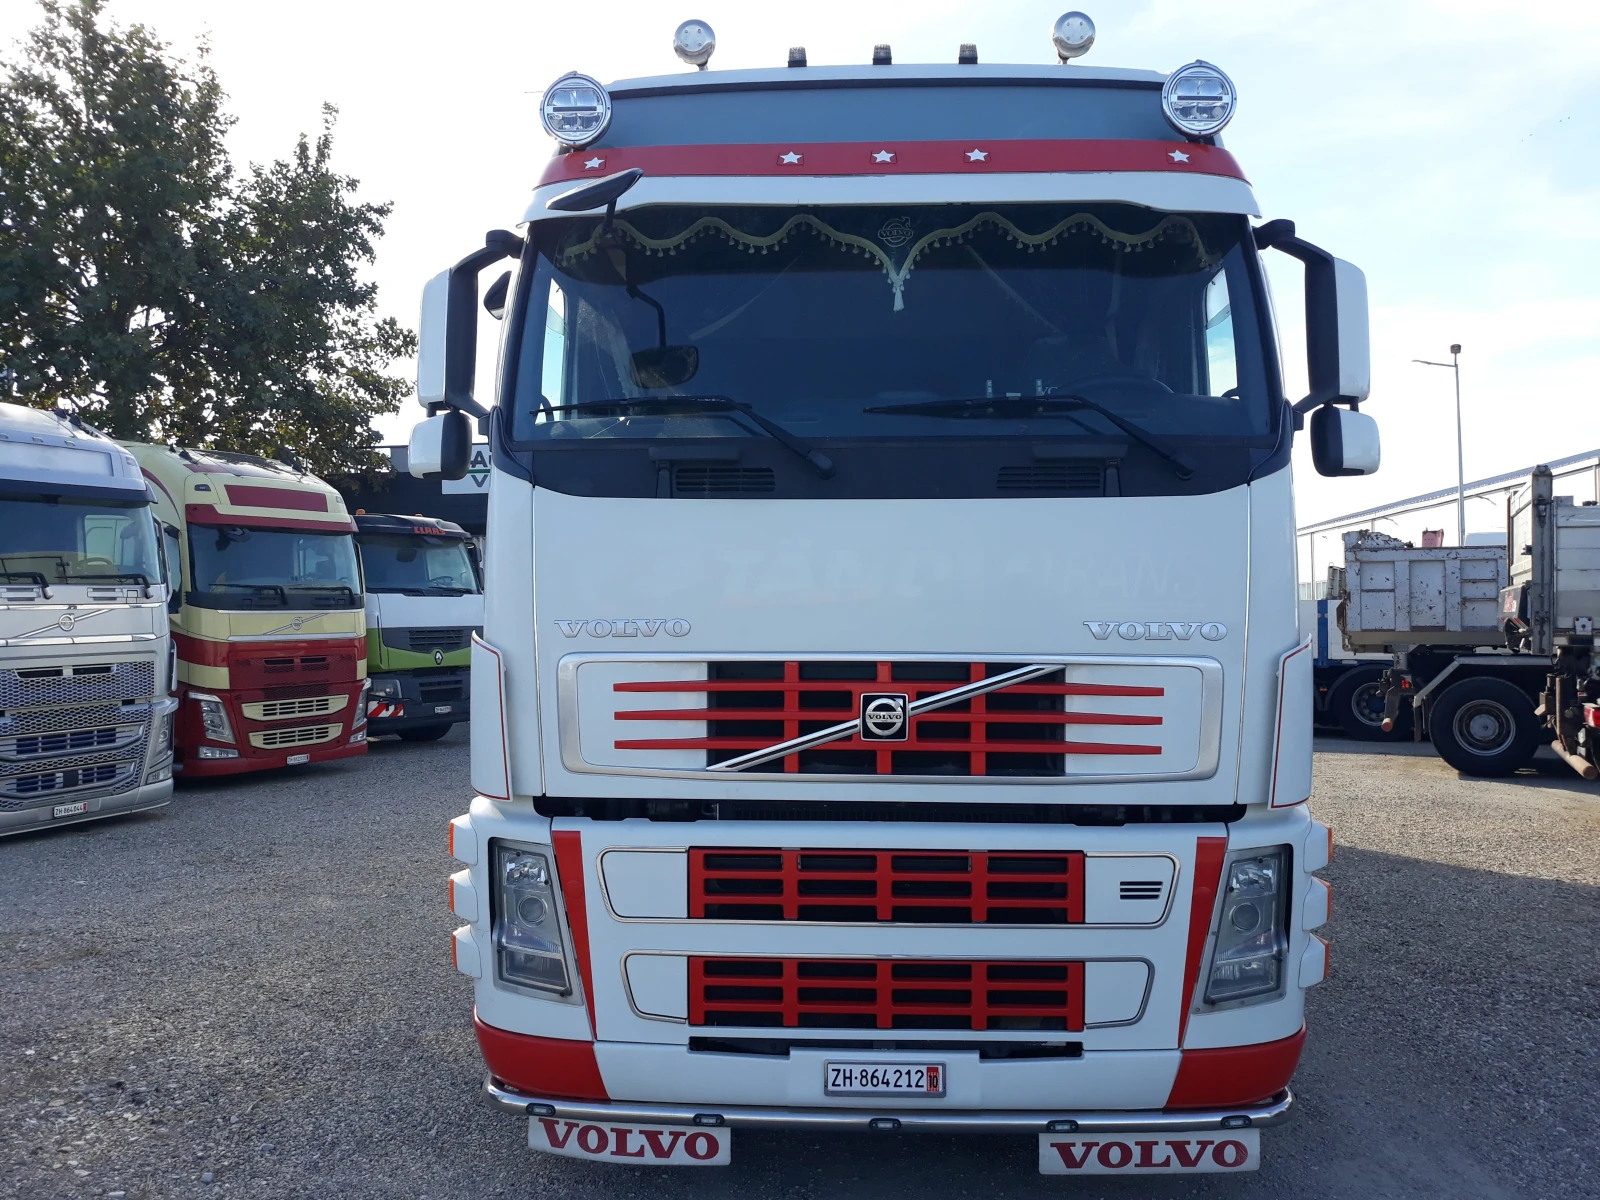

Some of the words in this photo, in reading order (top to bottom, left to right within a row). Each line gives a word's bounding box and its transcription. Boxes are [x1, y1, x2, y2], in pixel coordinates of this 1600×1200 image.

[880, 229, 911, 237] VOLVO
[554, 618, 692, 639] VOLVO
[1083, 621, 1228, 641] VOLVO
[538, 1117, 720, 1160] VOLVO
[1050, 1139, 1249, 1169] VOLVO
